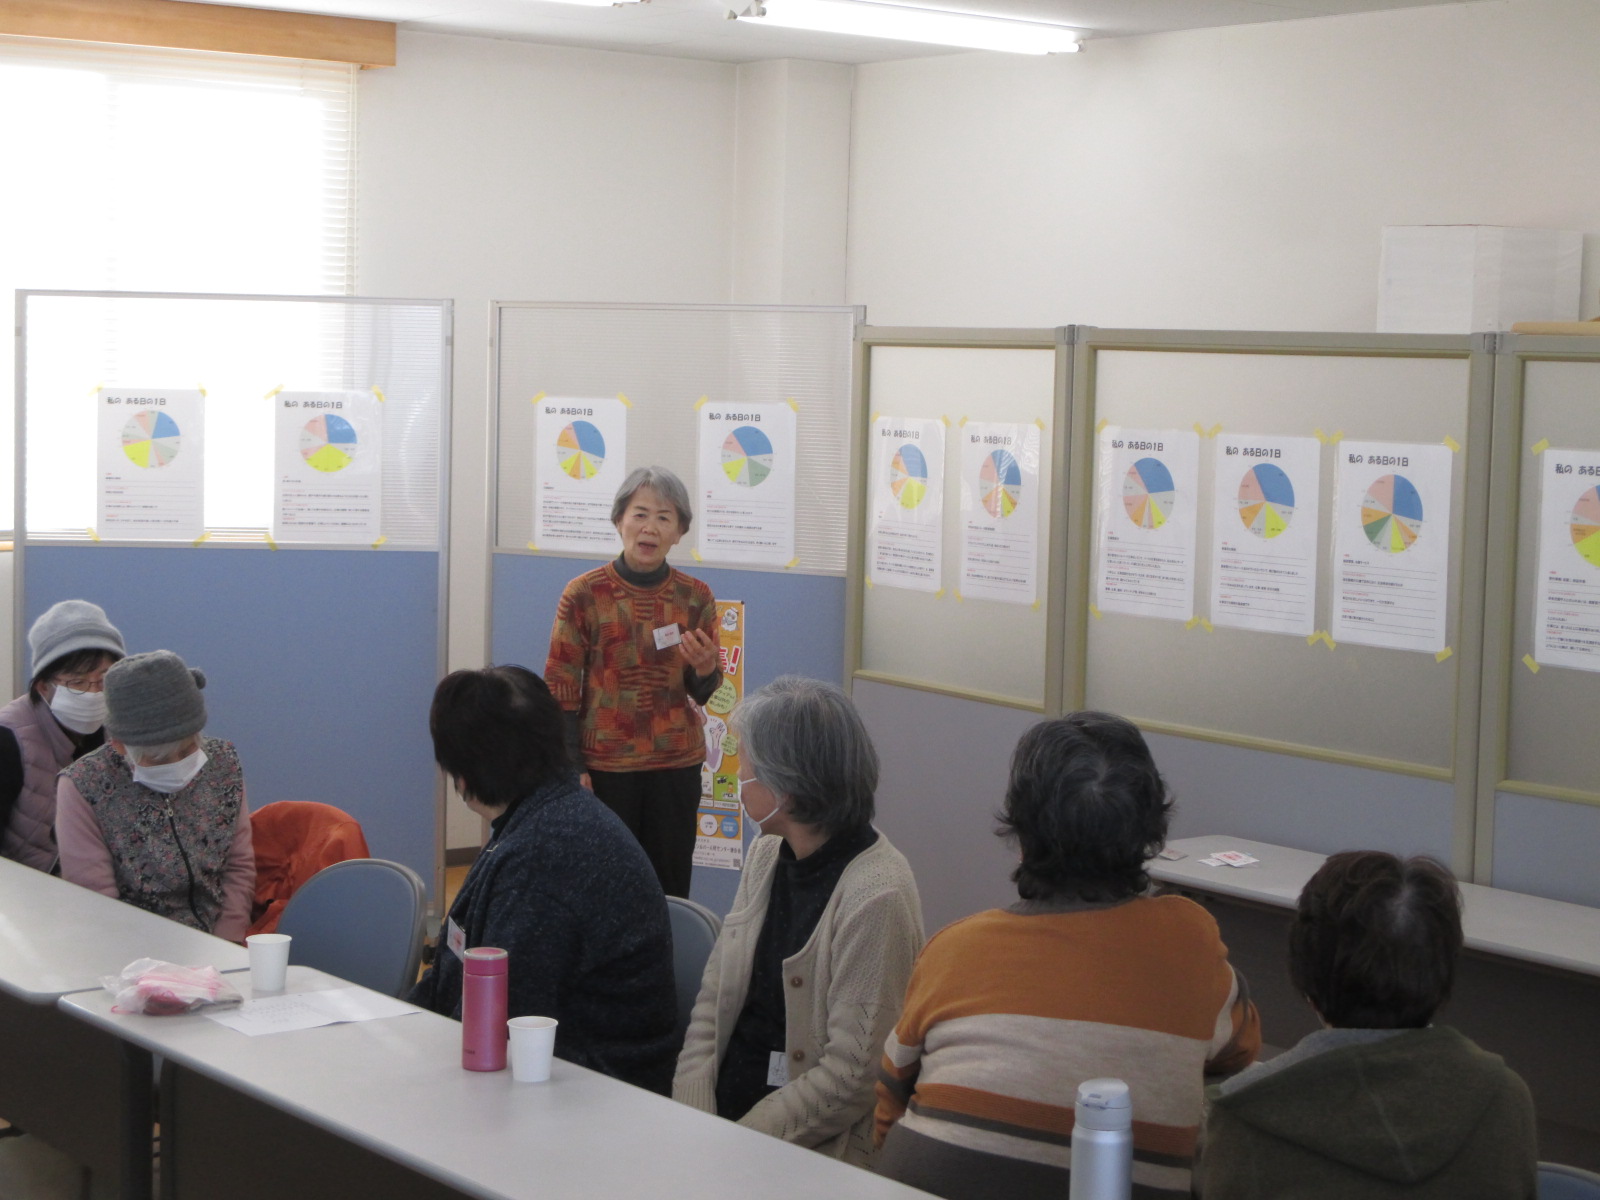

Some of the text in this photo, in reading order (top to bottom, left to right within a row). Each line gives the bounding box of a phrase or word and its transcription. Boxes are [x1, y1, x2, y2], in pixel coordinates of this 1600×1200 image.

[107, 397, 121, 405] 私の
[545, 406, 557, 415] 私の
[709, 412, 721, 421] 私の
[1111, 439, 1124, 449] 私の
[1225, 446, 1239, 456] 私の
[1348, 454, 1363, 464] 私の
[1555, 463, 1573, 474] 私の
